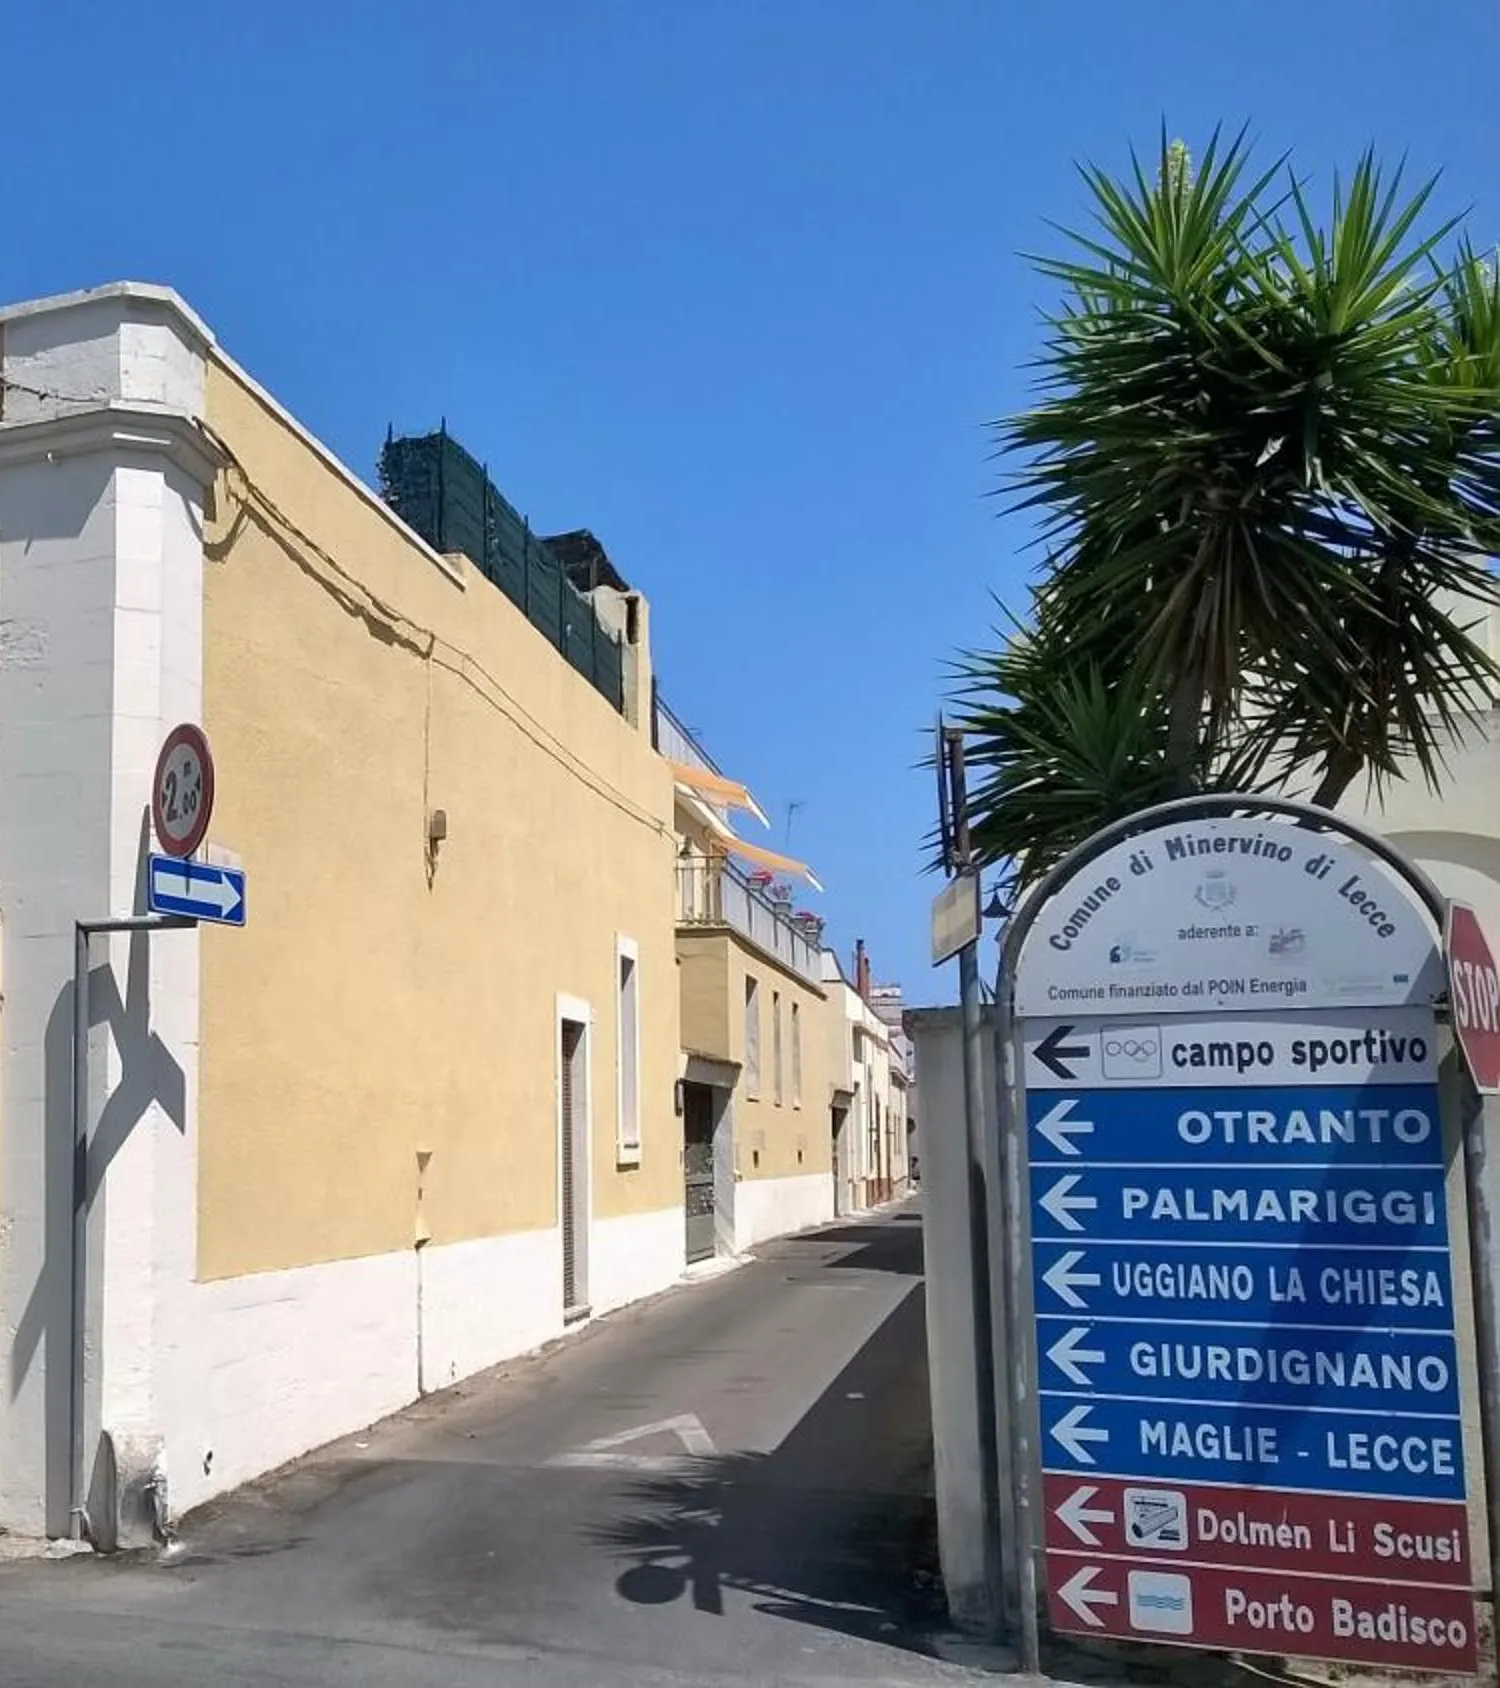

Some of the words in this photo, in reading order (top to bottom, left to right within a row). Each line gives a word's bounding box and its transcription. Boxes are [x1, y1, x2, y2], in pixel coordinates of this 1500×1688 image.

[1049, 876, 1122, 951] Comune
[1129, 849, 1154, 876] di
[1163, 833, 1293, 862] Minervino
[1304, 853, 1336, 880] di
[1337, 874, 1396, 939] Lecce
[1177, 923, 1241, 941] aderente
[1245, 924, 1259, 937] a:
[1048, 985, 1105, 1001] Comune
[1108, 982, 1177, 998] finanziato
[1181, 980, 1204, 996] dal
[1208, 979, 1245, 995] POIN
[1250, 977, 1307, 997] Energia
[1453, 959, 1500, 1033] STOP
[1171, 1036, 1275, 1073] campo
[1291, 1027, 1428, 1075] sportivo
[1177, 1110, 1430, 1143] OTRANTO
[1122, 1187, 1435, 1225] PALMARIGGI
[1112, 1261, 1254, 1299] UGGIANO
[1269, 1266, 1306, 1303] LA
[1320, 1267, 1445, 1308] CHIESA
[1130, 1342, 1449, 1391] GIURDIGNANO
[1140, 1420, 1279, 1464] MAGLIE
[1327, 1431, 1456, 1475] LECCE
[1329, 1518, 1356, 1554] Li
[1373, 1522, 1462, 1564] Scusi
[1224, 1589, 1314, 1633] Porto
[1332, 1598, 1468, 1650] Badisco
